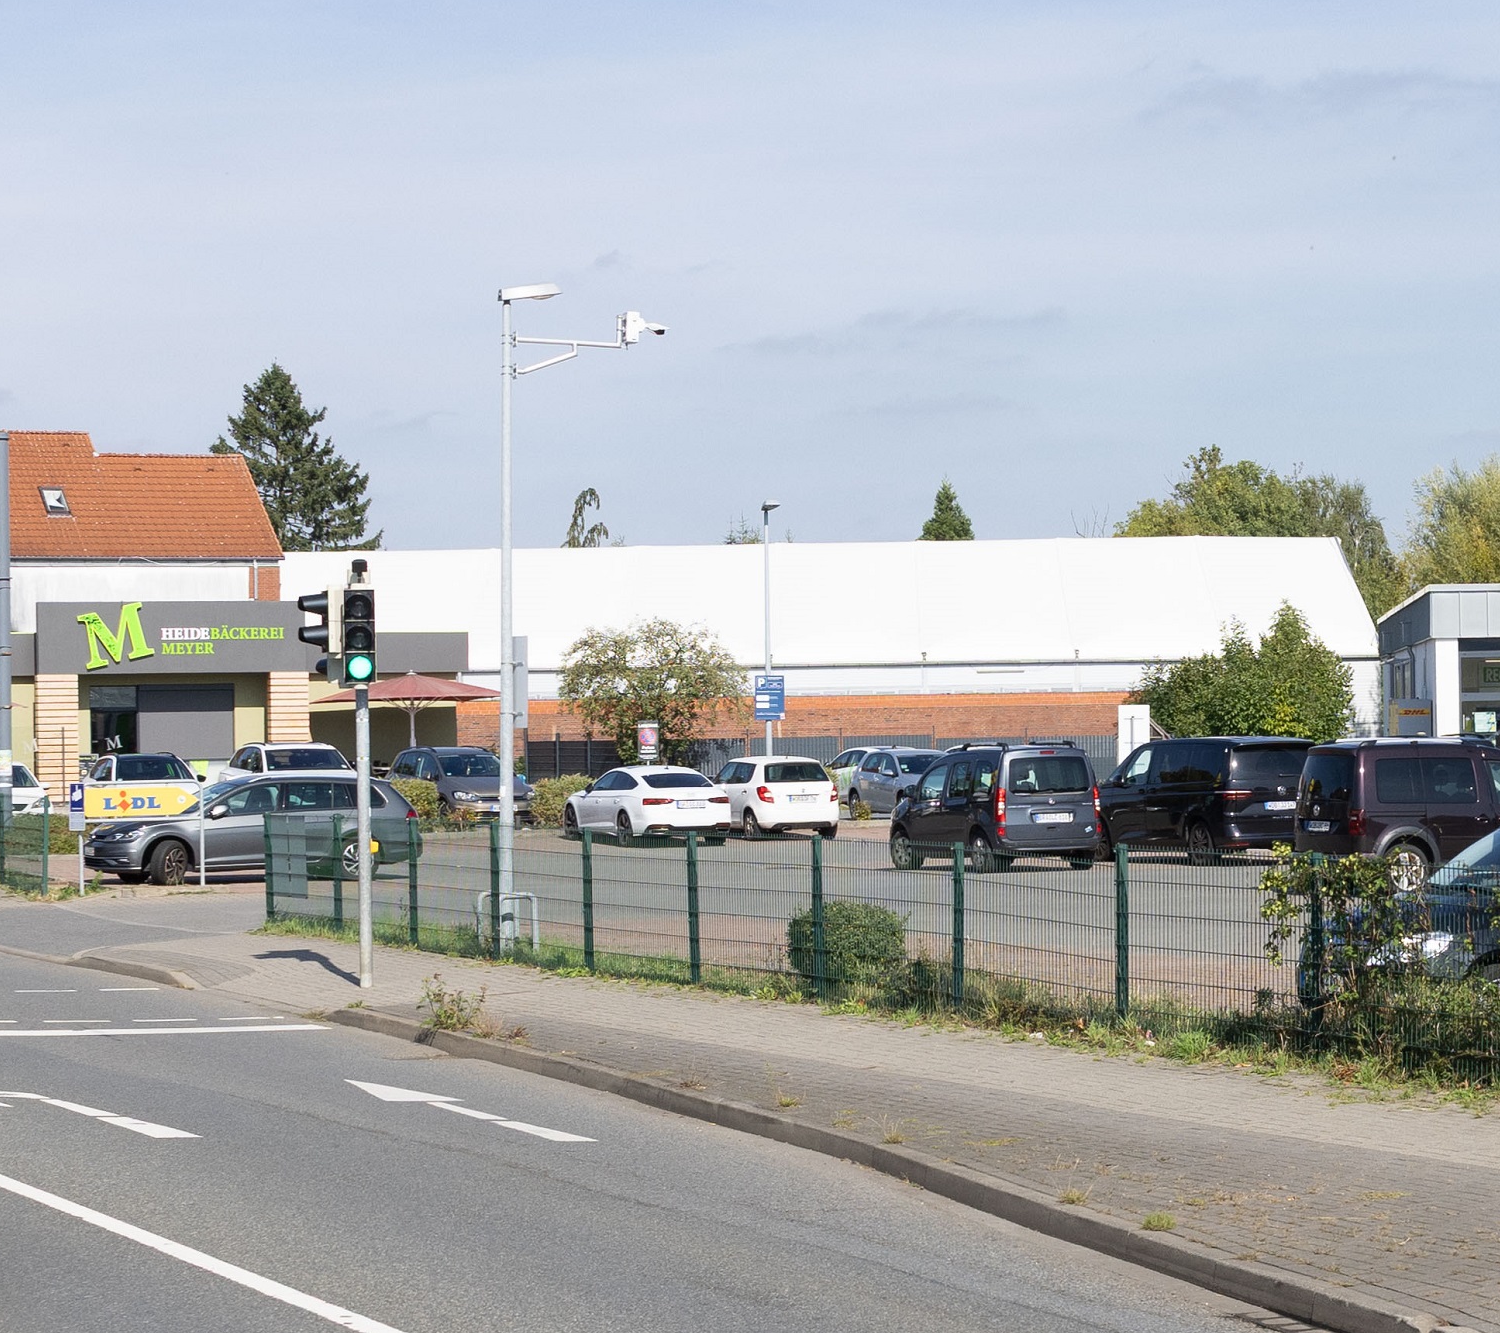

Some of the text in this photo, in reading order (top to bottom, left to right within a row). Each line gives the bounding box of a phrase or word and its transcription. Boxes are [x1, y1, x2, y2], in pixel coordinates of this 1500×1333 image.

[77, 601, 155, 669] M
[160, 625, 285, 641] HEIDEBÄCKEREI
[161, 642, 215, 655] MEYER
[757, 677, 766, 688] P
